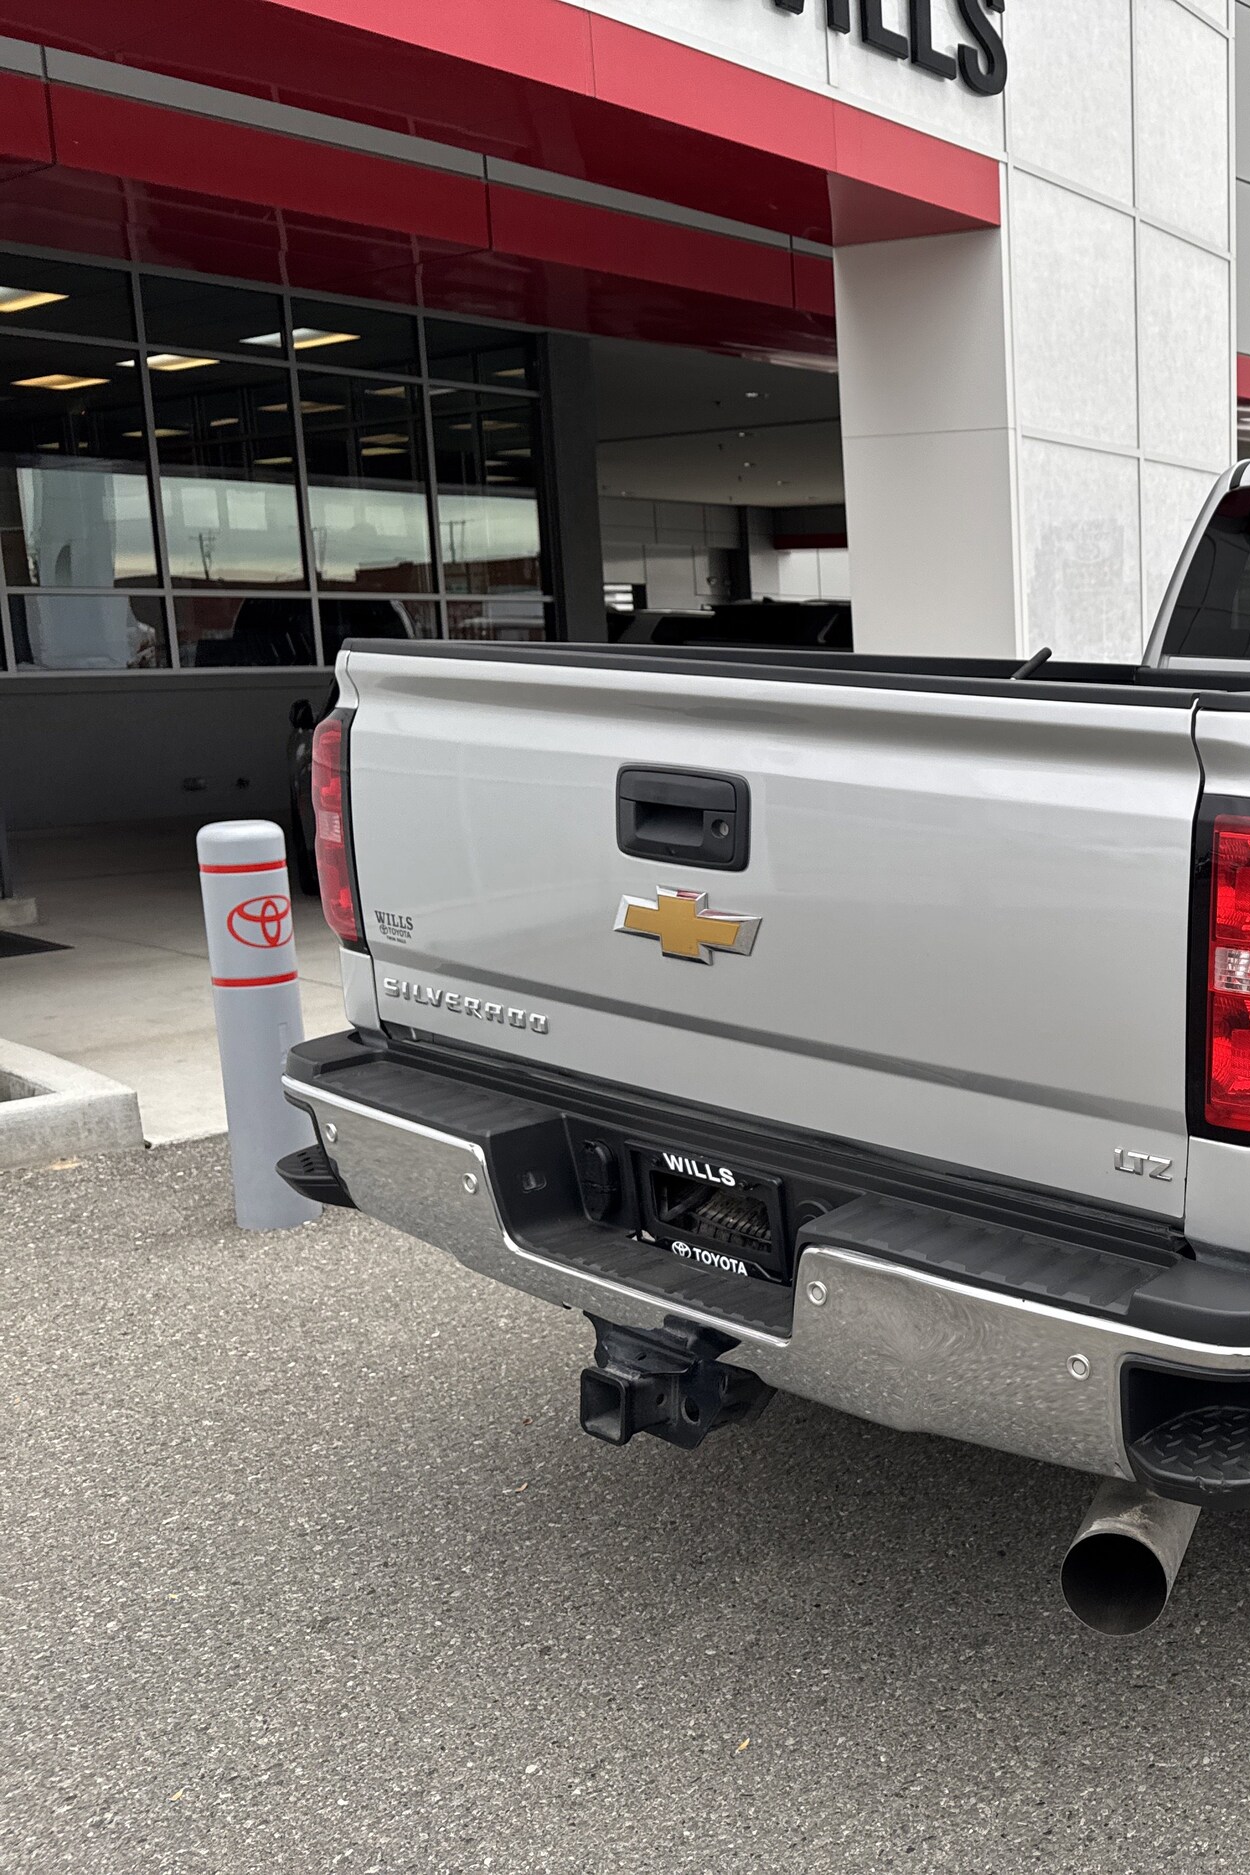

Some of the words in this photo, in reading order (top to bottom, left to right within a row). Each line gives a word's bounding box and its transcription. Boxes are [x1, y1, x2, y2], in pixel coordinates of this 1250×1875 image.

[374, 910, 413, 931] WILLS
[387, 926, 412, 939] TOYOTA
[383, 977, 549, 1034] SILVERADO
[662, 1152, 735, 1186] WILLS
[1113, 1148, 1173, 1182] LTZ
[692, 1247, 748, 1276] TOYOTA
